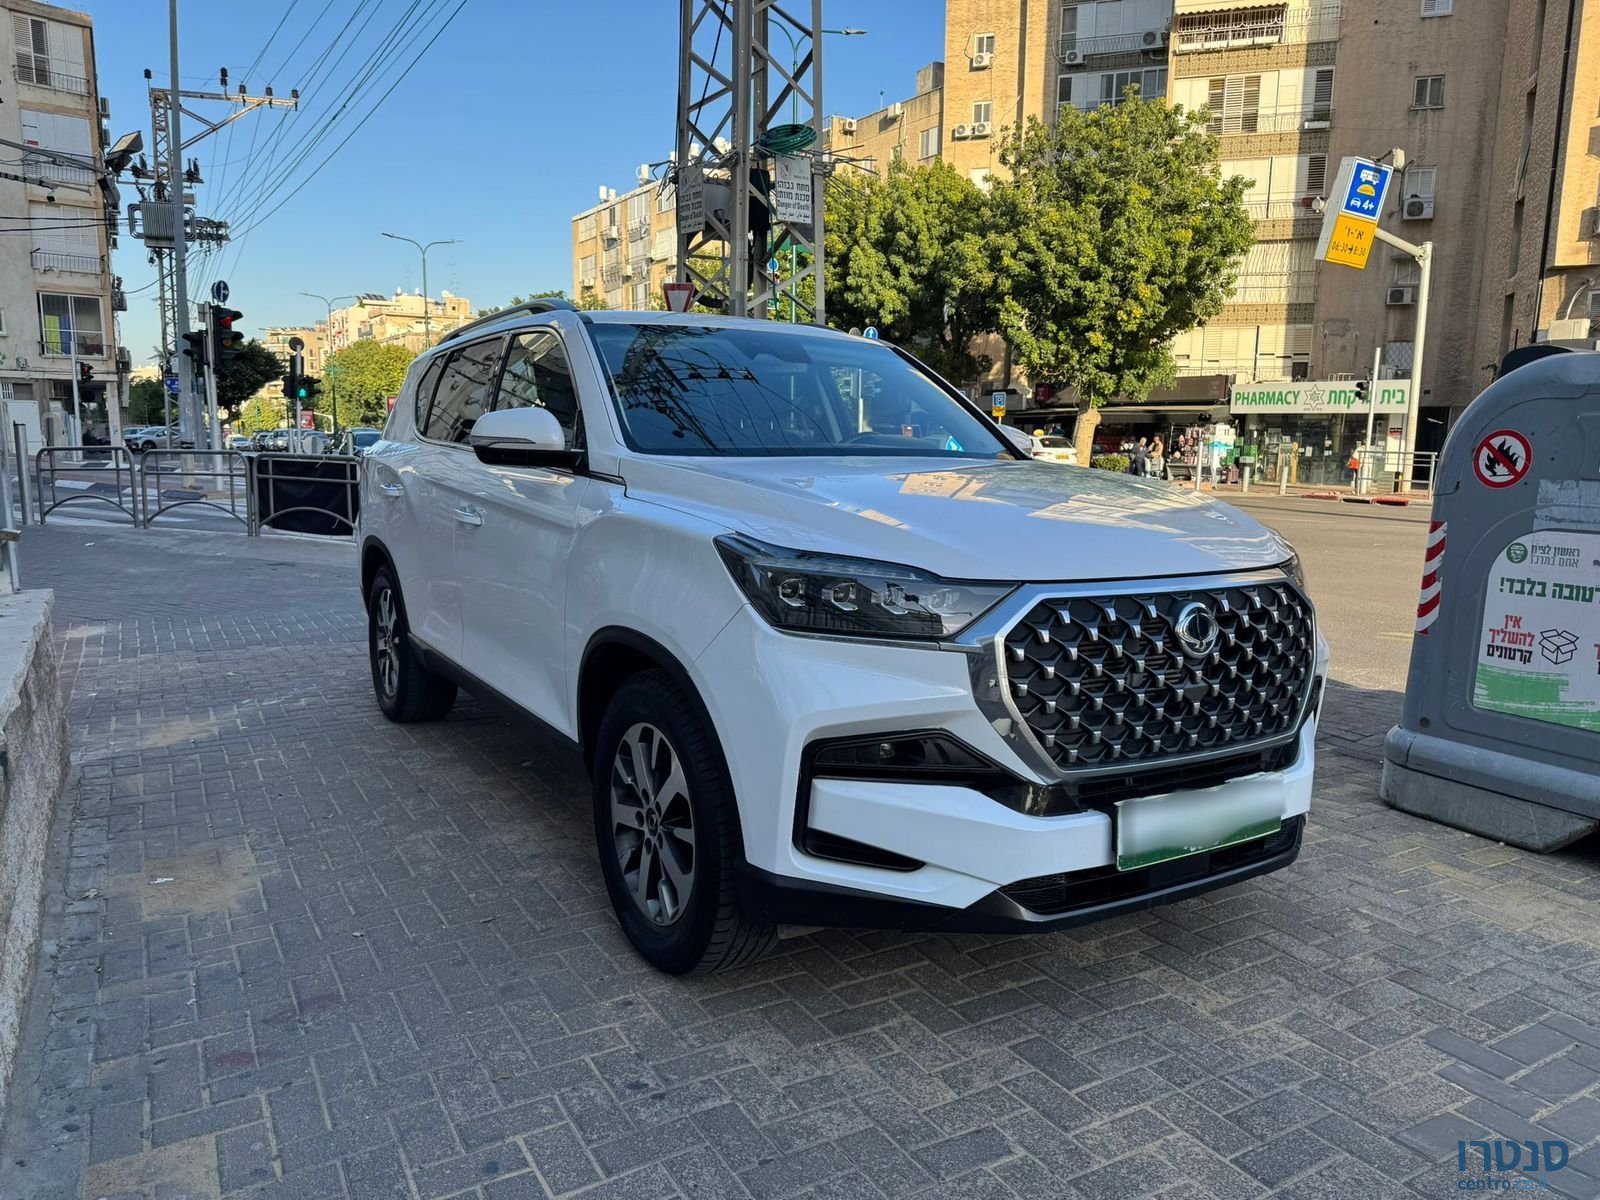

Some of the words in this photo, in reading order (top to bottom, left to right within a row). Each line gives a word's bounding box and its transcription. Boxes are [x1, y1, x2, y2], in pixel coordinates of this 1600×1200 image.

[1362, 199, 1374, 211] 4+
[1234, 390, 1300, 405] PHARMACY
[1326, 389, 1371, 409] קחת
[1379, 389, 1406, 405] בית
[1531, 544, 1551, 555] לציון
[1553, 546, 1580, 558] ראשון
[1531, 555, 1555, 566] במרכז
[1558, 557, 1579, 568] אתם
[1500, 577, 1547, 597] בלבד!
[1504, 614, 1522, 629] אין
[1488, 628, 1535, 647] להשליך
[1486, 644, 1533, 665] קרטונים
